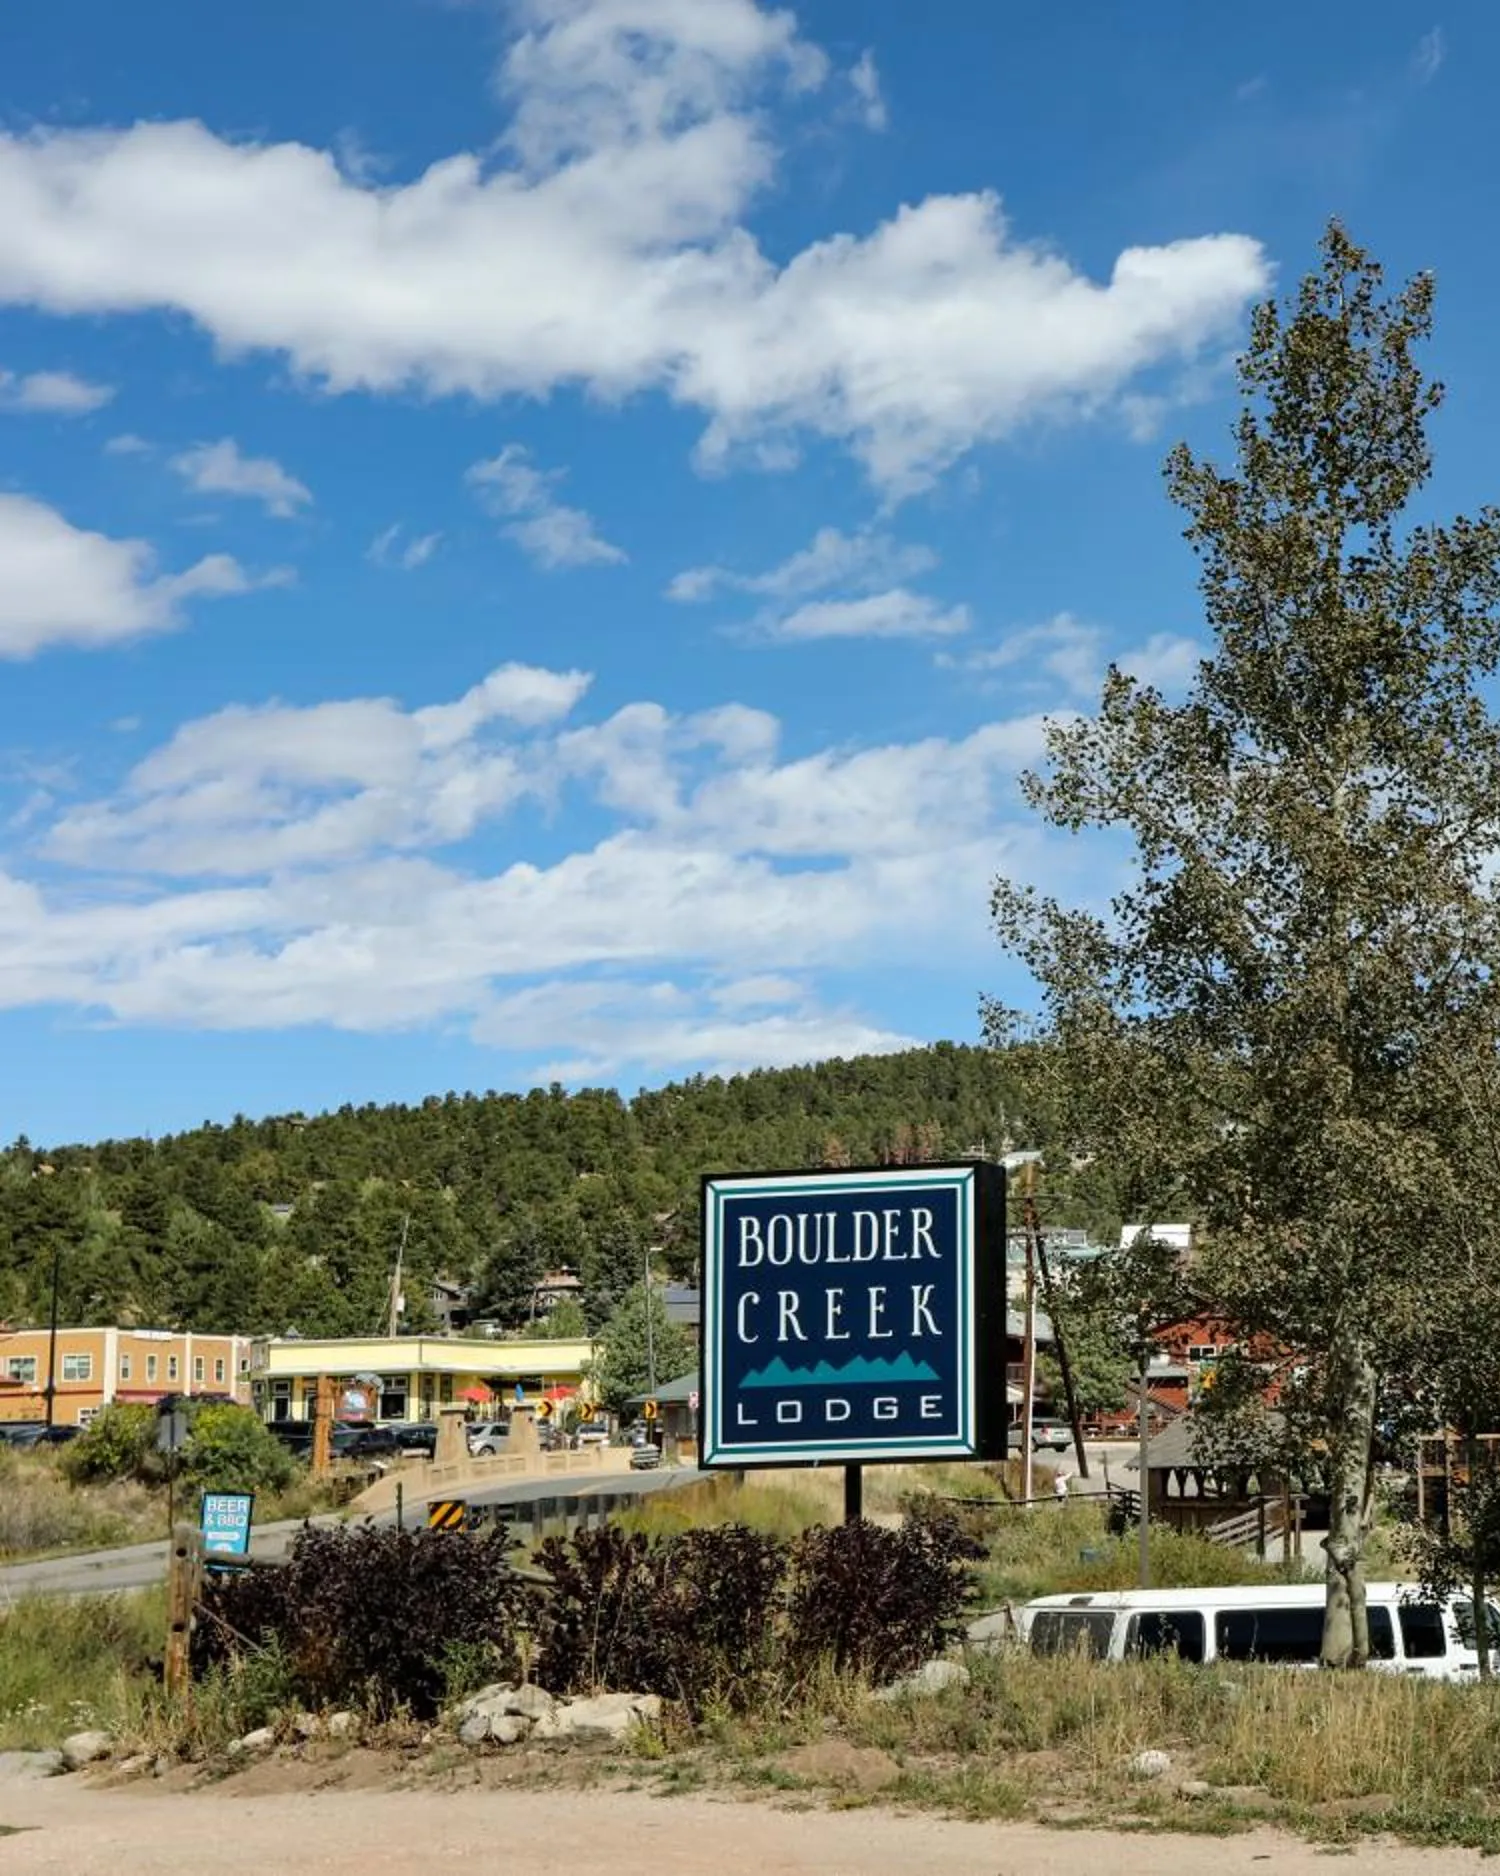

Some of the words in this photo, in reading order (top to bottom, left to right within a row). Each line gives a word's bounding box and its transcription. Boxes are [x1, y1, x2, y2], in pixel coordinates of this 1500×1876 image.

[738, 1207, 943, 1268] BOULDER
[737, 1283, 943, 1344] CREEK
[737, 1394, 943, 1426] LODGE
[207, 1498, 247, 1513] BEER
